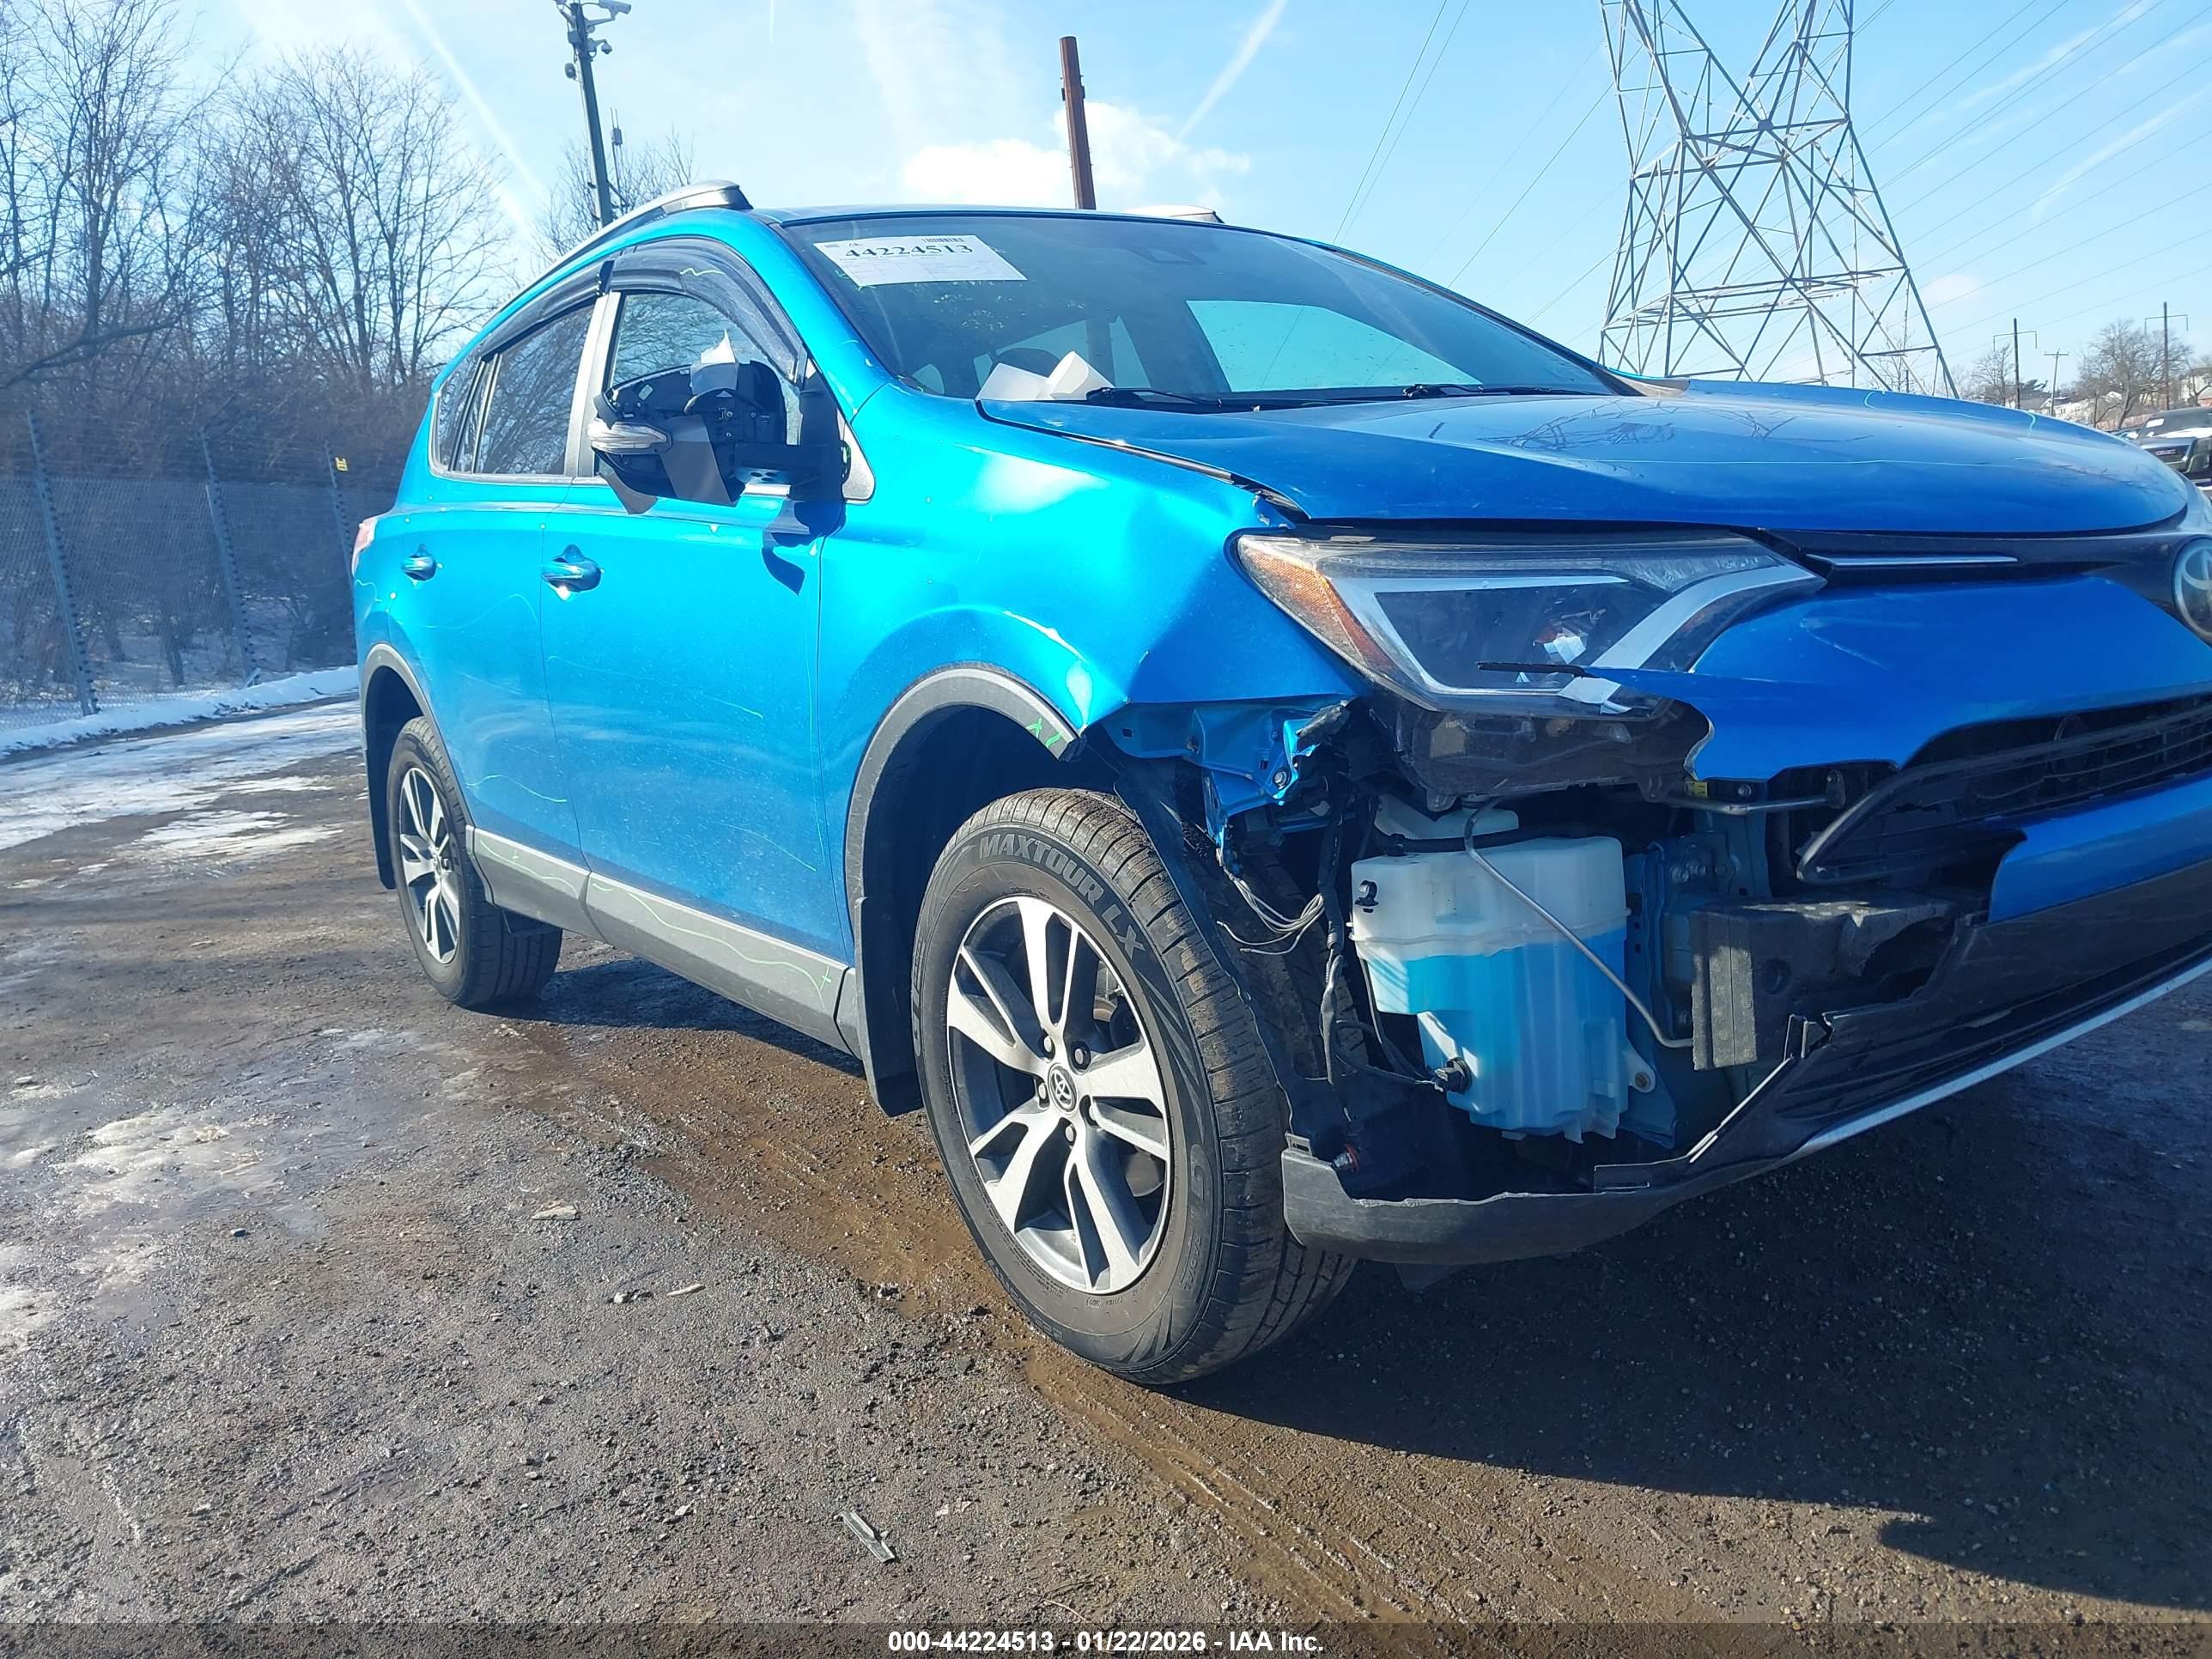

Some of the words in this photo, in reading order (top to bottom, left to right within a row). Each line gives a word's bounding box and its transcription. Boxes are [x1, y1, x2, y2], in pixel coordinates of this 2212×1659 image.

[846, 245, 973, 257] 44224513
[978, 833, 1105, 907] MAXTOUR
[1101, 903, 1146, 960] LX
